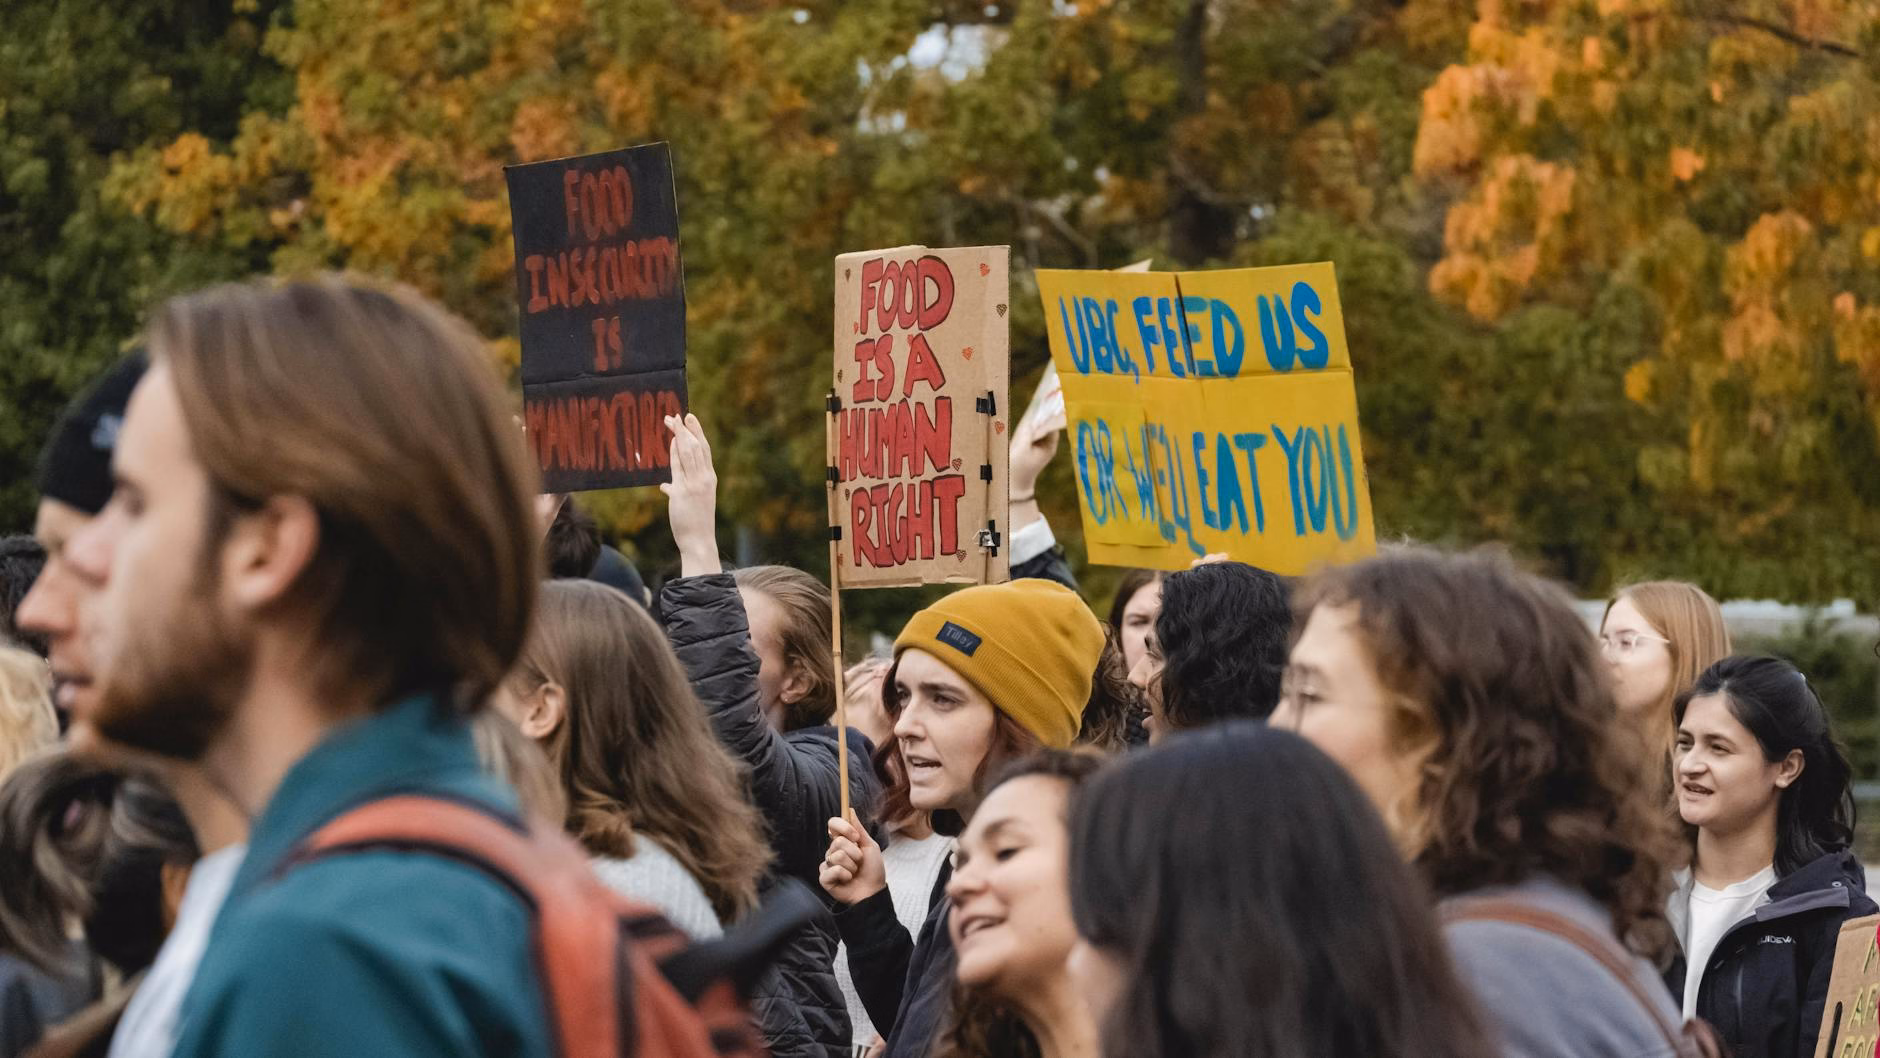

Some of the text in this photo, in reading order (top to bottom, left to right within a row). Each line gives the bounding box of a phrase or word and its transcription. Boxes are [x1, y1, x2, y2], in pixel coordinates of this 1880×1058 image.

[563, 165, 633, 241] FOOD
[860, 255, 955, 335] FOOD
[1059, 281, 1329, 384] UBC, FEED US
[592, 316, 623, 372] IS
[853, 332, 946, 404] IS A
[839, 396, 952, 483] HUMAN
[1077, 417, 1129, 525] OR
[1193, 432, 1267, 536] EAT
[1271, 422, 1359, 541] YOU
[852, 474, 965, 568] RIGHT
